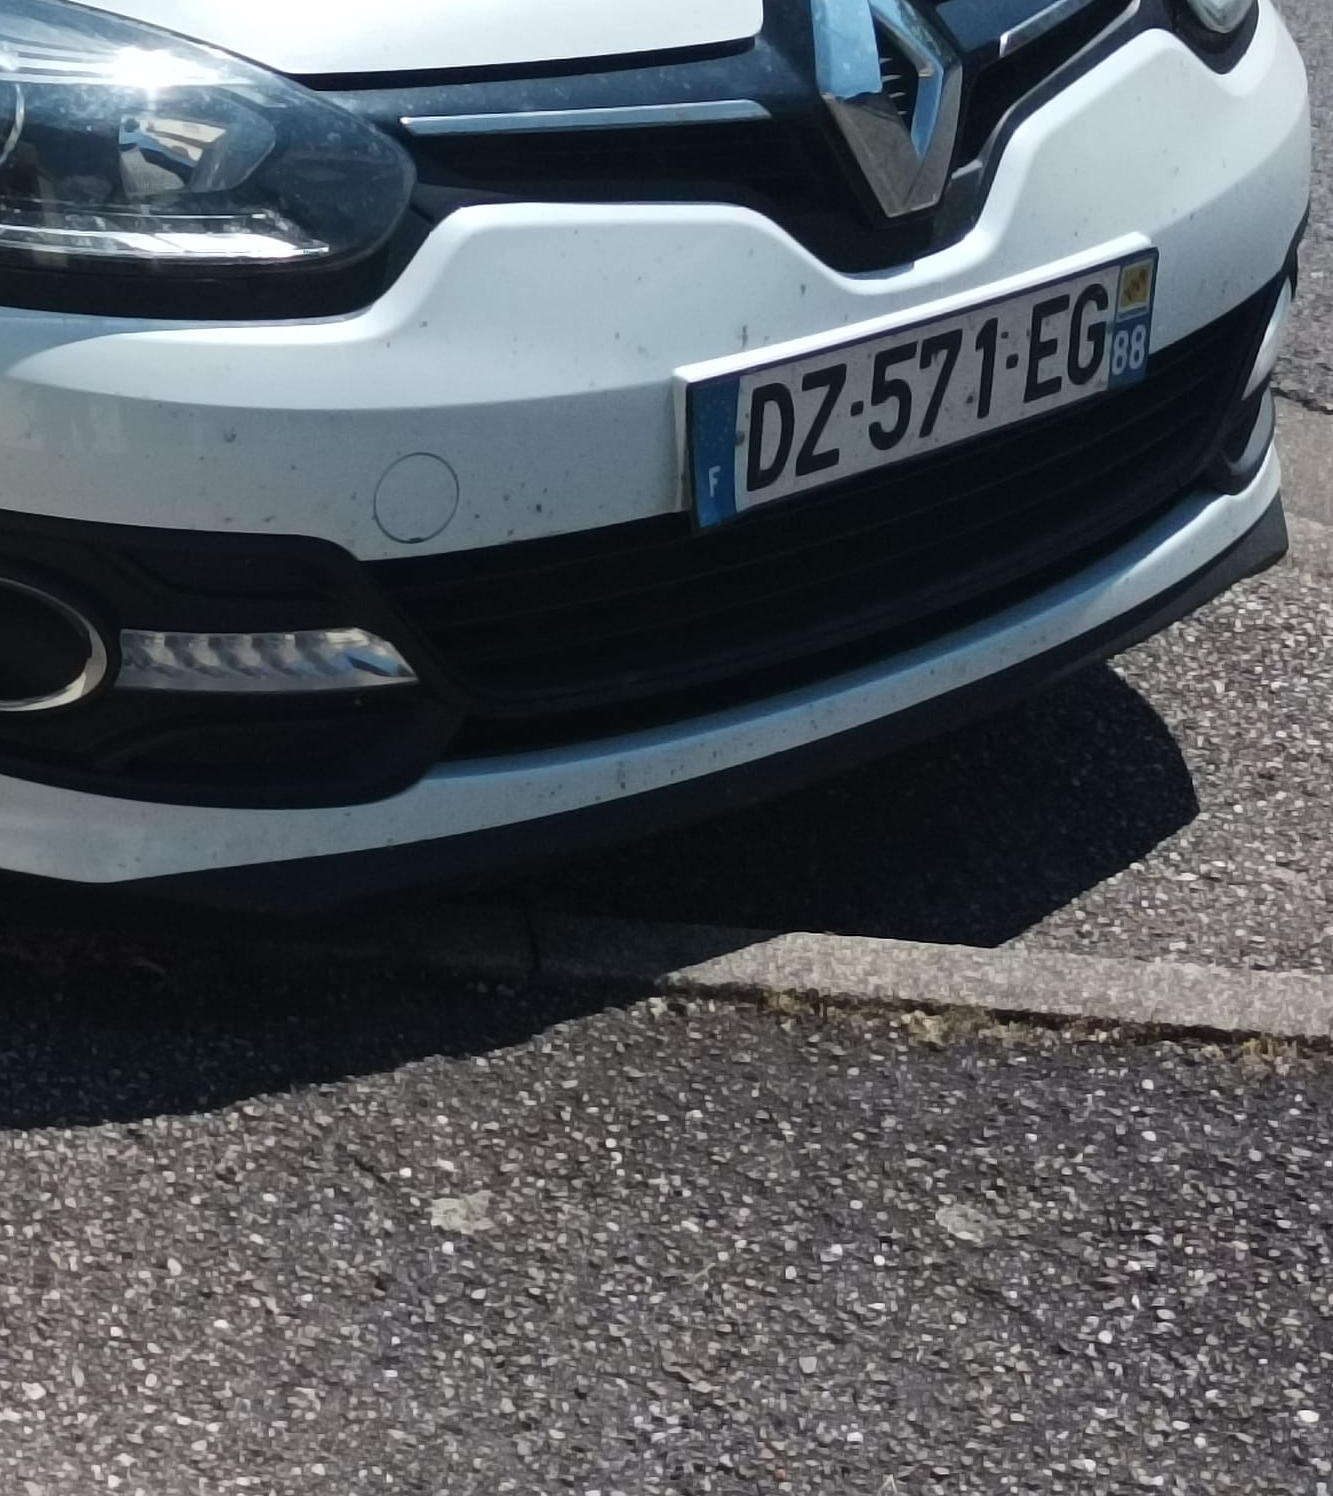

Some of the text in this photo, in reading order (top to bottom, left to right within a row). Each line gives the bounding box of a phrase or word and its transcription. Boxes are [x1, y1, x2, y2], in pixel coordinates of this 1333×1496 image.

[1111, 323, 1147, 376] 88
[745, 283, 1110, 493] DZ-571-EG
[707, 465, 721, 498] F
